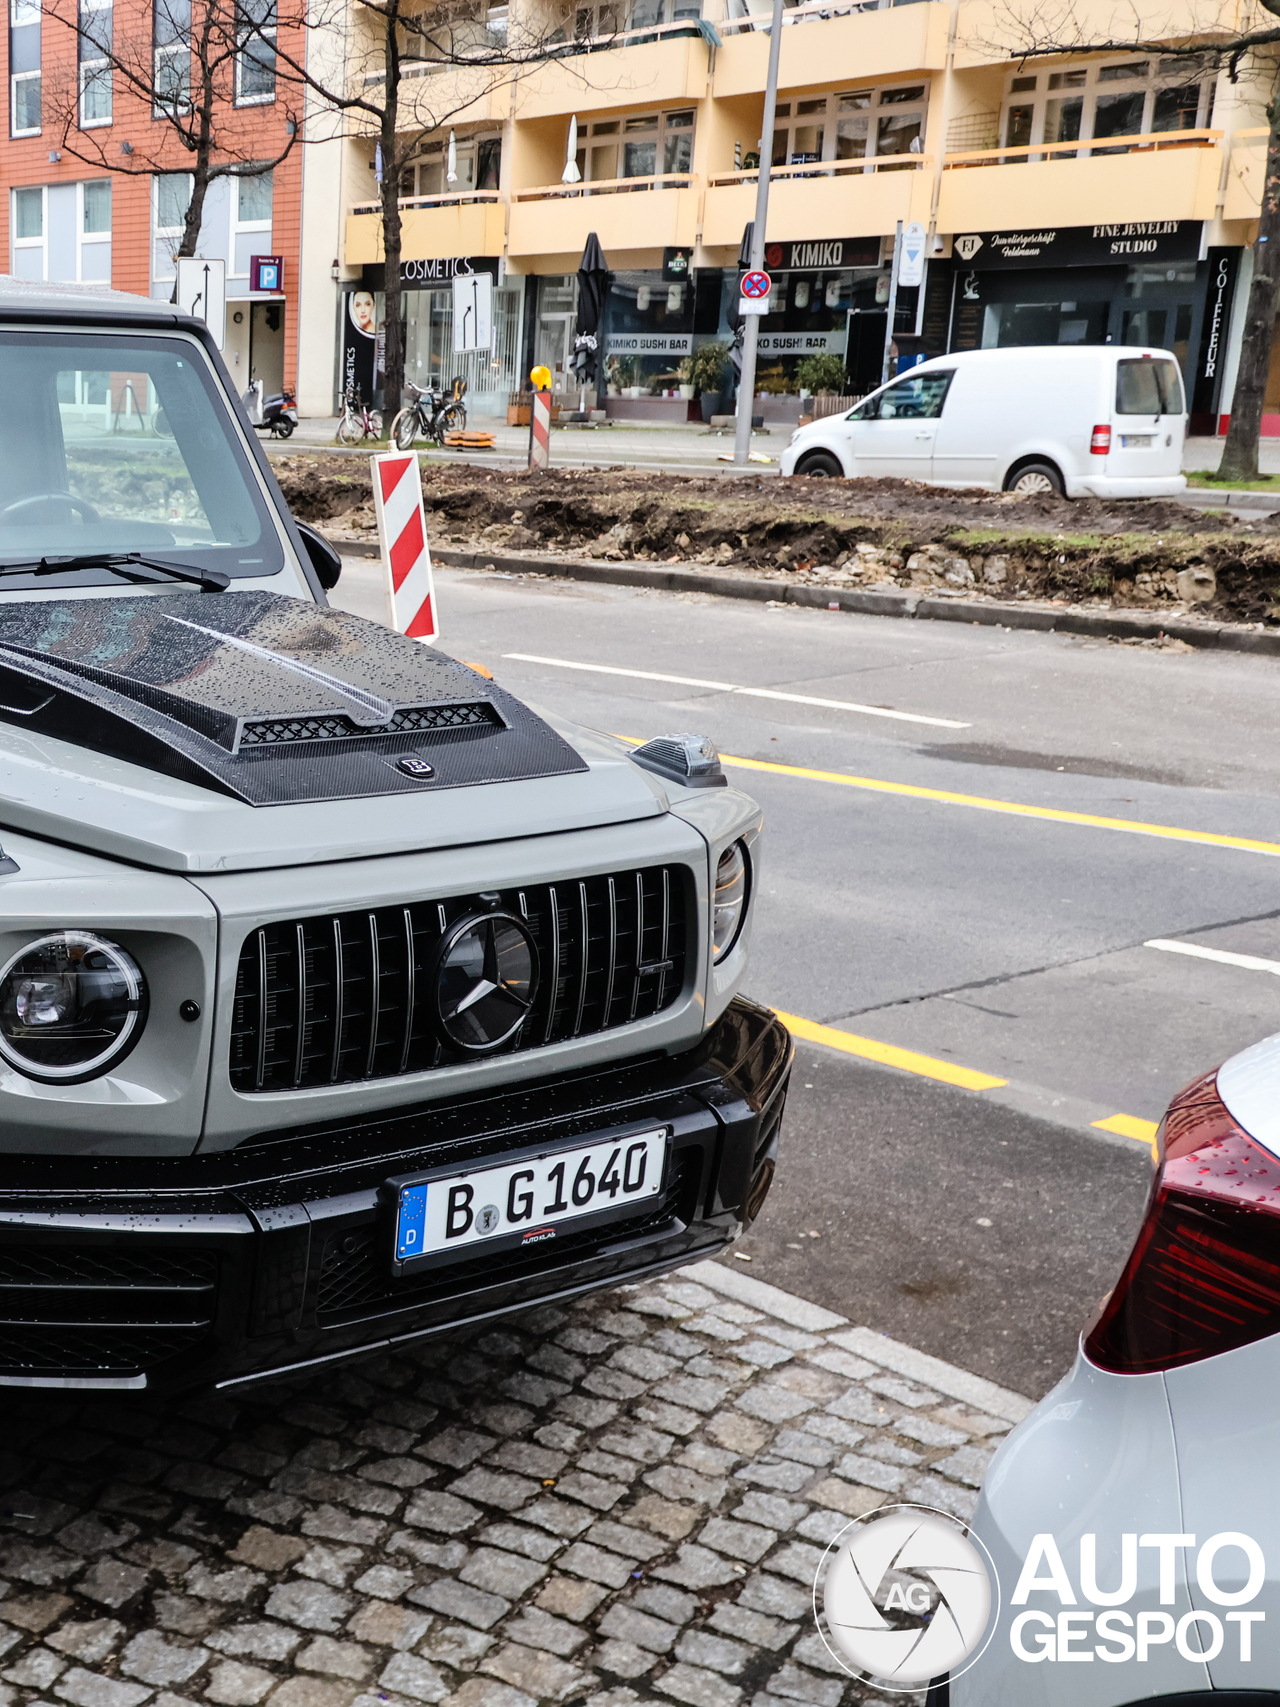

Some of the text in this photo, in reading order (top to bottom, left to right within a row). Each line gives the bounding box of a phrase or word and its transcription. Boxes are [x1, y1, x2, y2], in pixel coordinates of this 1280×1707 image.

[1092, 220, 1180, 238] FINE JEWELRY
[962, 239, 975, 252] FJ
[1001, 246, 1041, 257] Feldmann
[1109, 239, 1158, 254] STUDIO
[790, 242, 843, 267] KIMIKO
[263, 267, 275, 286] P
[1204, 258, 1229, 377] COIFFEUR
[607, 339, 688, 349] KIMIKO SUSHI BAR
[805, 338, 827, 348] BAR
[405, 1229, 416, 1245] D
[445, 1184, 474, 1240] B
[521, 1231, 556, 1245] AUTO KLAS
